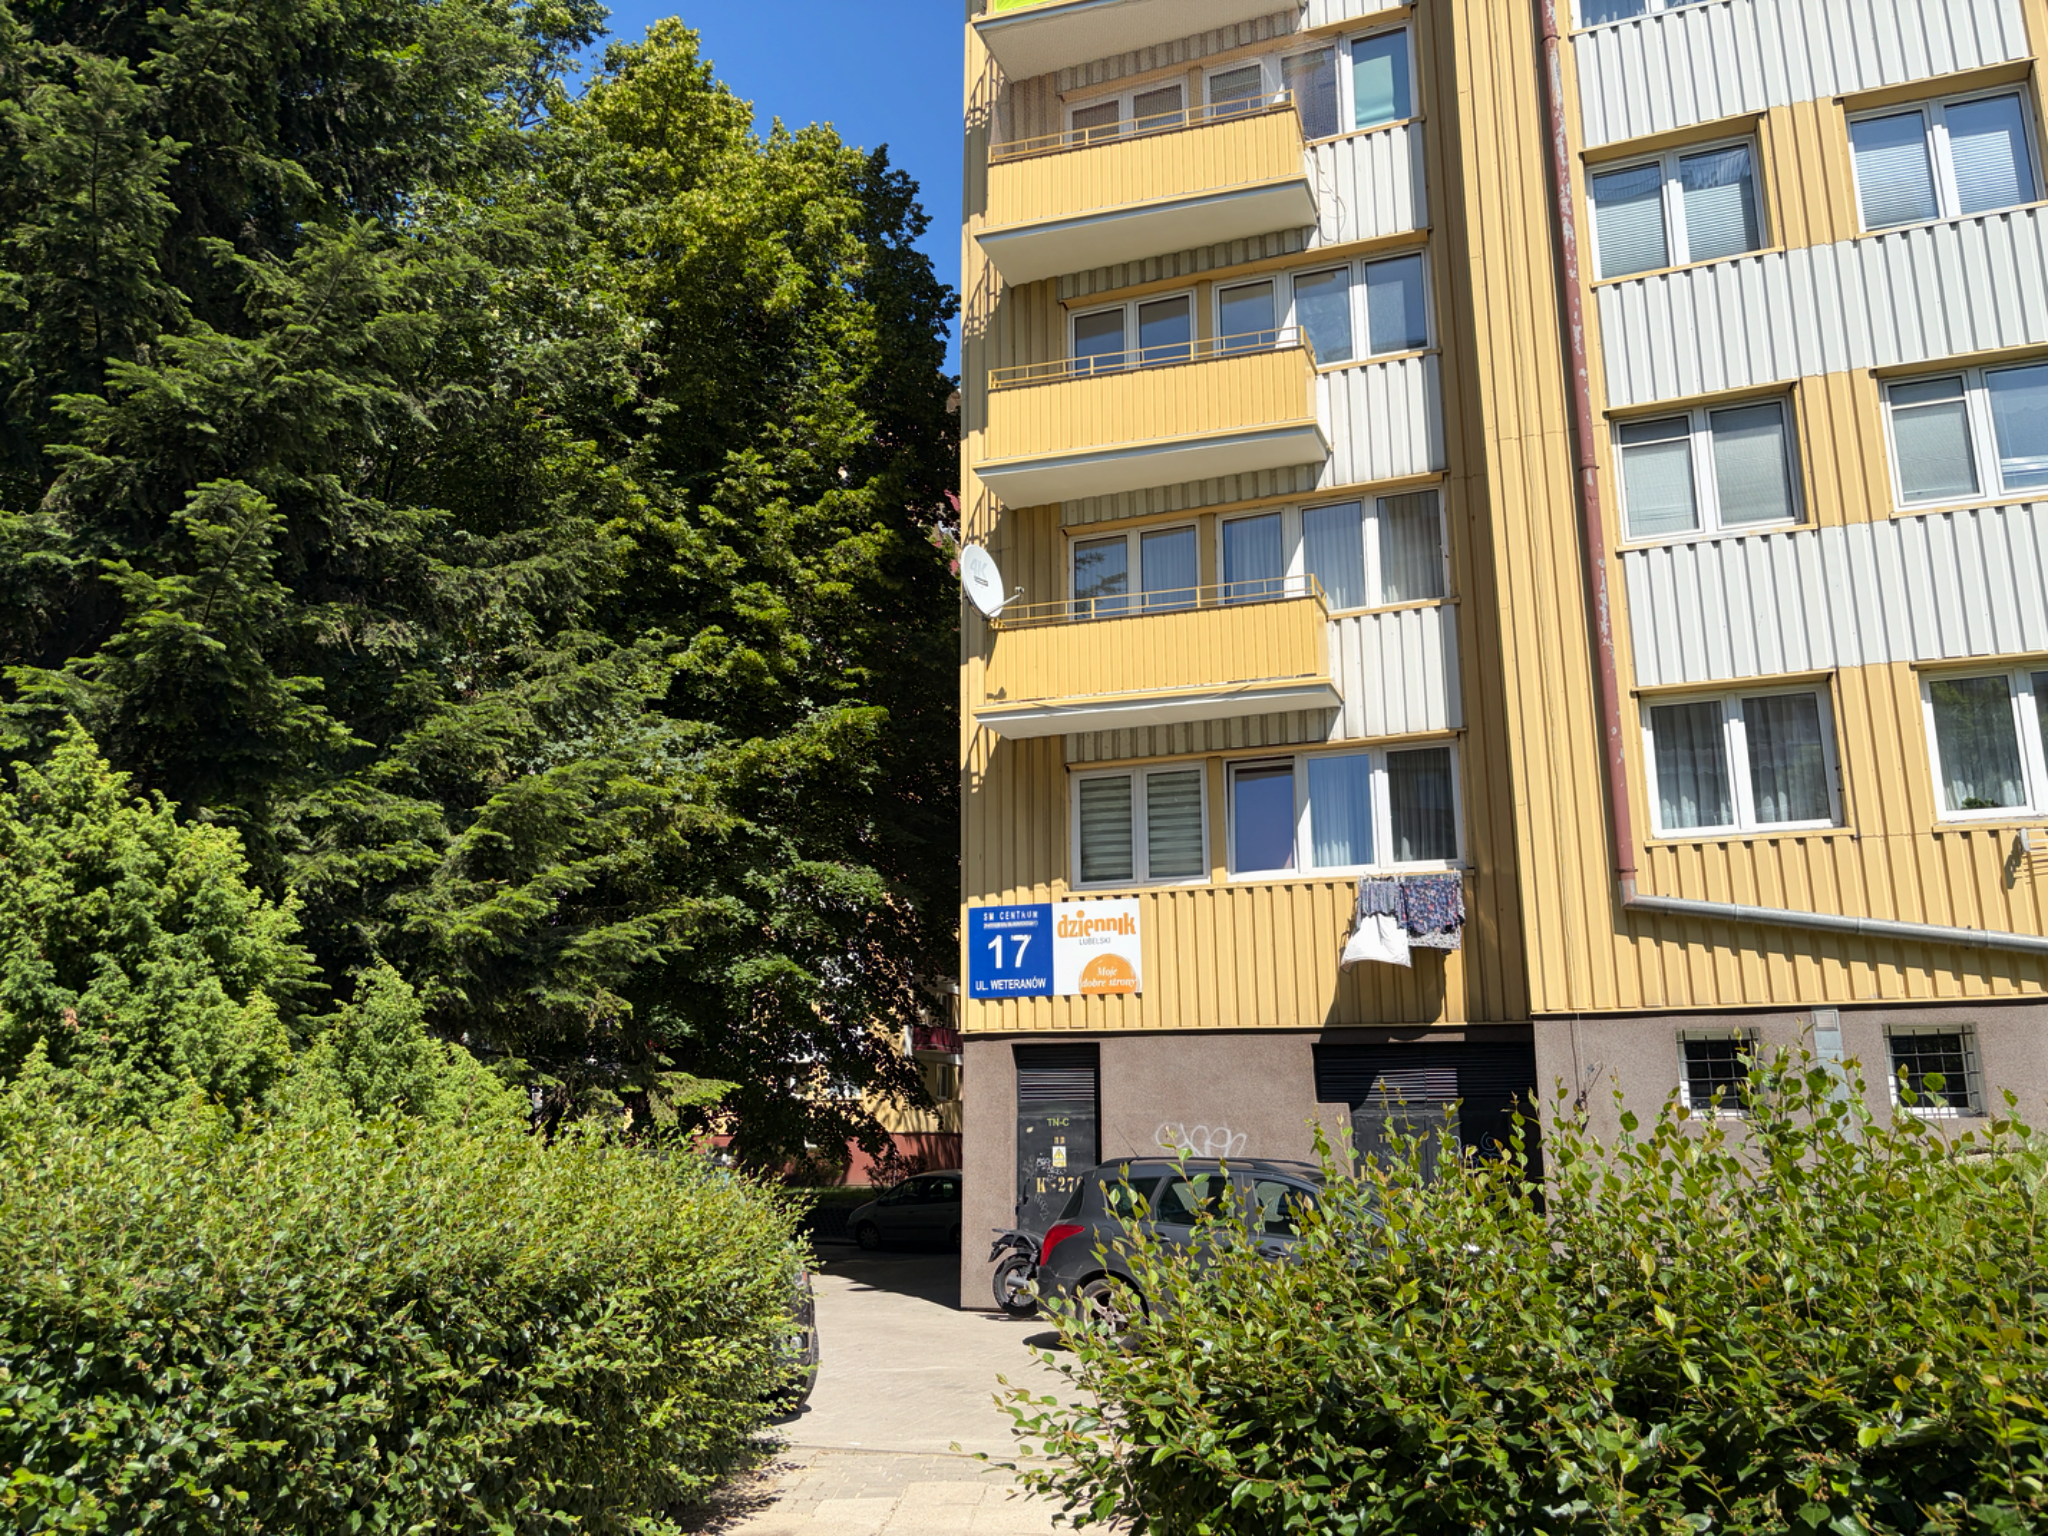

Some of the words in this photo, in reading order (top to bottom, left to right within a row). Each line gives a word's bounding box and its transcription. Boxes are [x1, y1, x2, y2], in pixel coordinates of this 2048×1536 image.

[1000, 911, 1038, 920] CENTRUM
[1057, 909, 1136, 938] dziennik
[1079, 937, 1111, 946] LUBELSKI
[988, 934, 1032, 969] 17
[1097, 966, 1118, 977] Moje
[975, 981, 989, 991] UL.
[990, 975, 1047, 990] WETERANÓW
[1081, 978, 1106, 988] dobre
[1108, 978, 1136, 988] strony
[1047, 1117, 1070, 1127] TN-C
